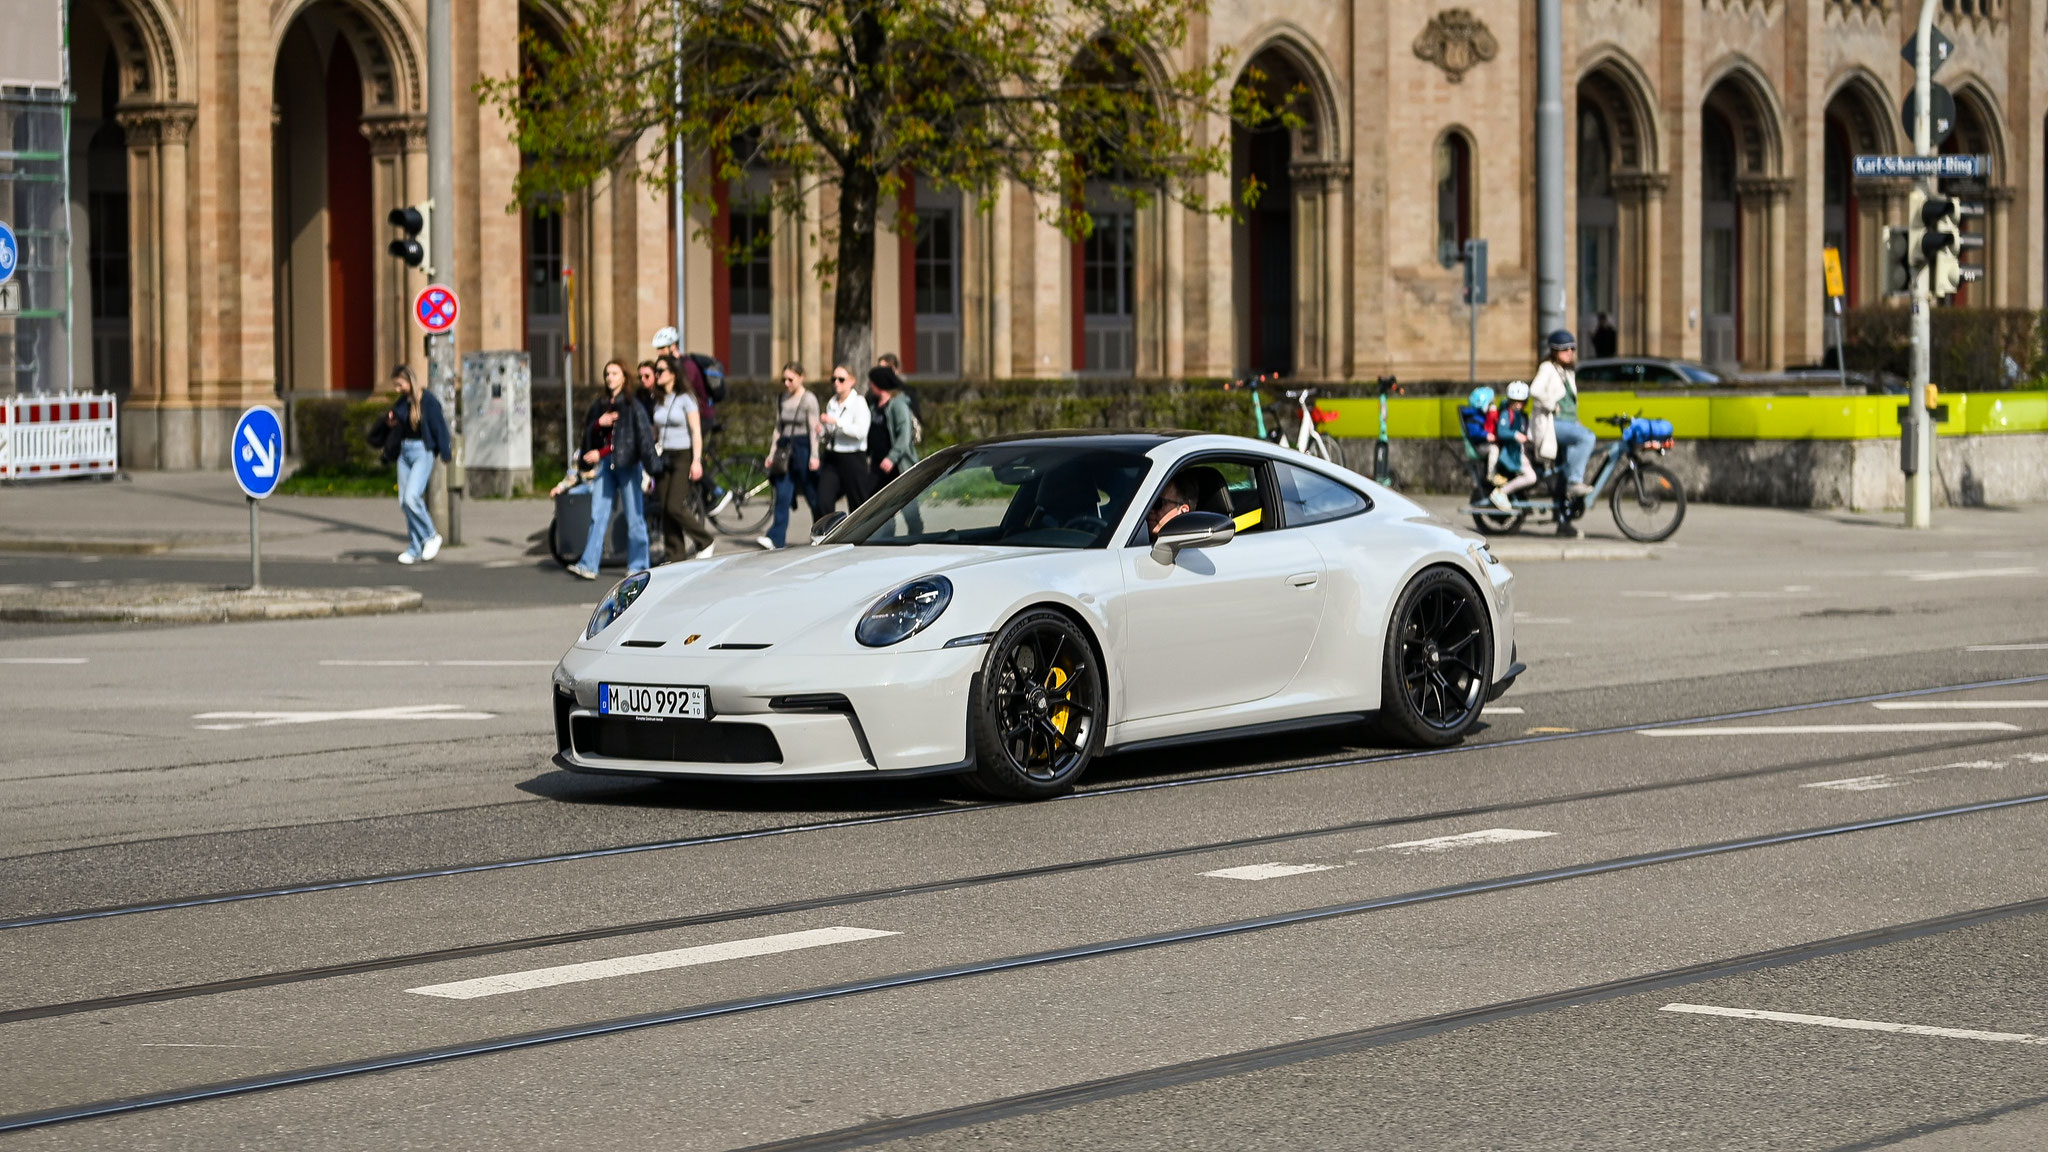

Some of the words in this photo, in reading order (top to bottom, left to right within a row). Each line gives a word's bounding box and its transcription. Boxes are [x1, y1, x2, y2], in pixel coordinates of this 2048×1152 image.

[1856, 156, 1972, 176] Karl-Scharnagl-Ring
[602, 701, 607, 709] D
[609, 688, 619, 711] M
[629, 689, 651, 713] UO
[655, 690, 689, 714] 992
[693, 707, 701, 715] 10
